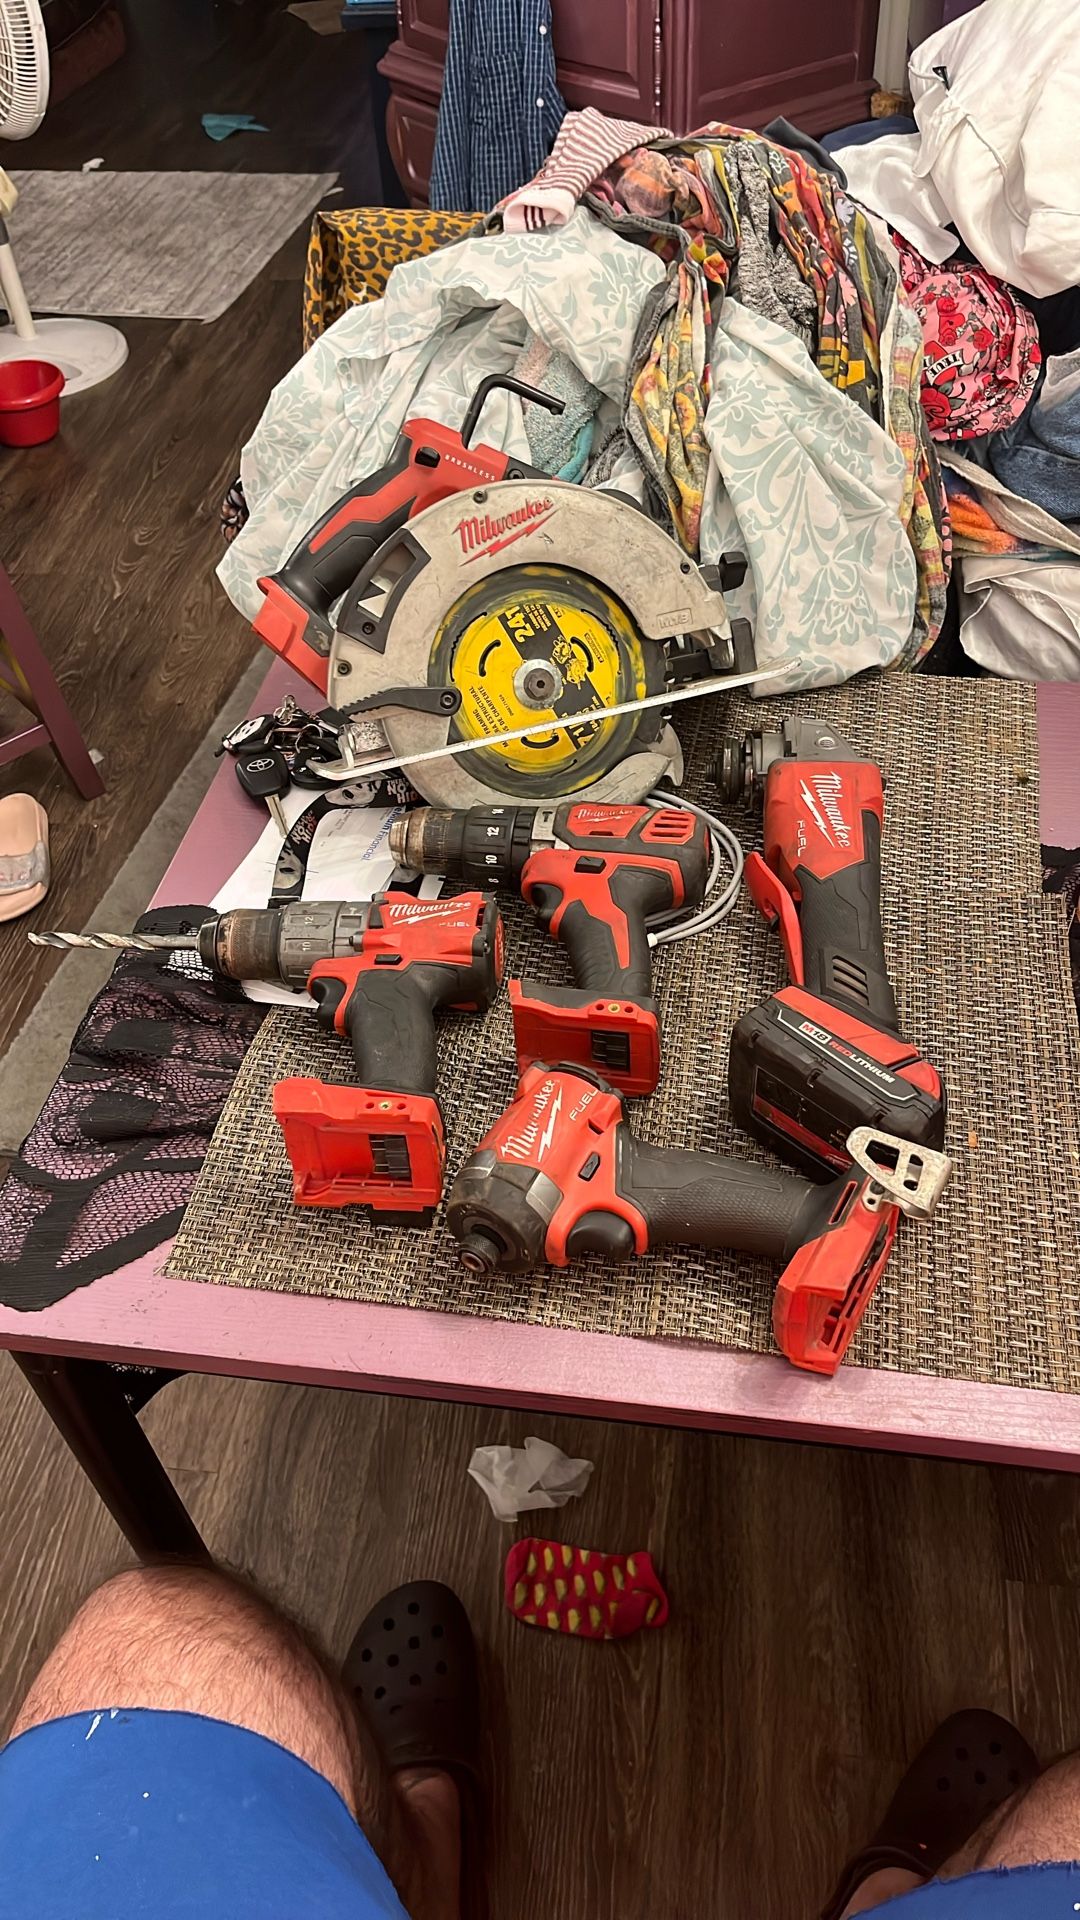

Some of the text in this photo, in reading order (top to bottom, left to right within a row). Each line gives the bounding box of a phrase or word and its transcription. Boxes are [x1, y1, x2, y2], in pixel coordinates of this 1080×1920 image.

[929, 353, 958, 378] TRUE
[444, 453, 496, 481] BRUSHLESS
[451, 496, 554, 554] Milwaukee
[468, 686, 495, 725] ESTRUCTURAL
[478, 685, 501, 718] CHARPENTE
[472, 709, 492, 735] FRAMING
[808, 771, 852, 849] Milwaukee
[361, 830, 389, 861] Financial
[486, 826, 500, 837] 12
[796, 820, 807, 857] FUEL
[485, 854, 498, 865] 10
[304, 915, 314, 925] 12
[389, 901, 472, 918] Milwaukee
[302, 941, 311, 952] 10
[801, 1023, 830, 1042] M18
[500, 1079, 556, 1159] Milwaukee
[568, 1089, 600, 1121] FUEL
